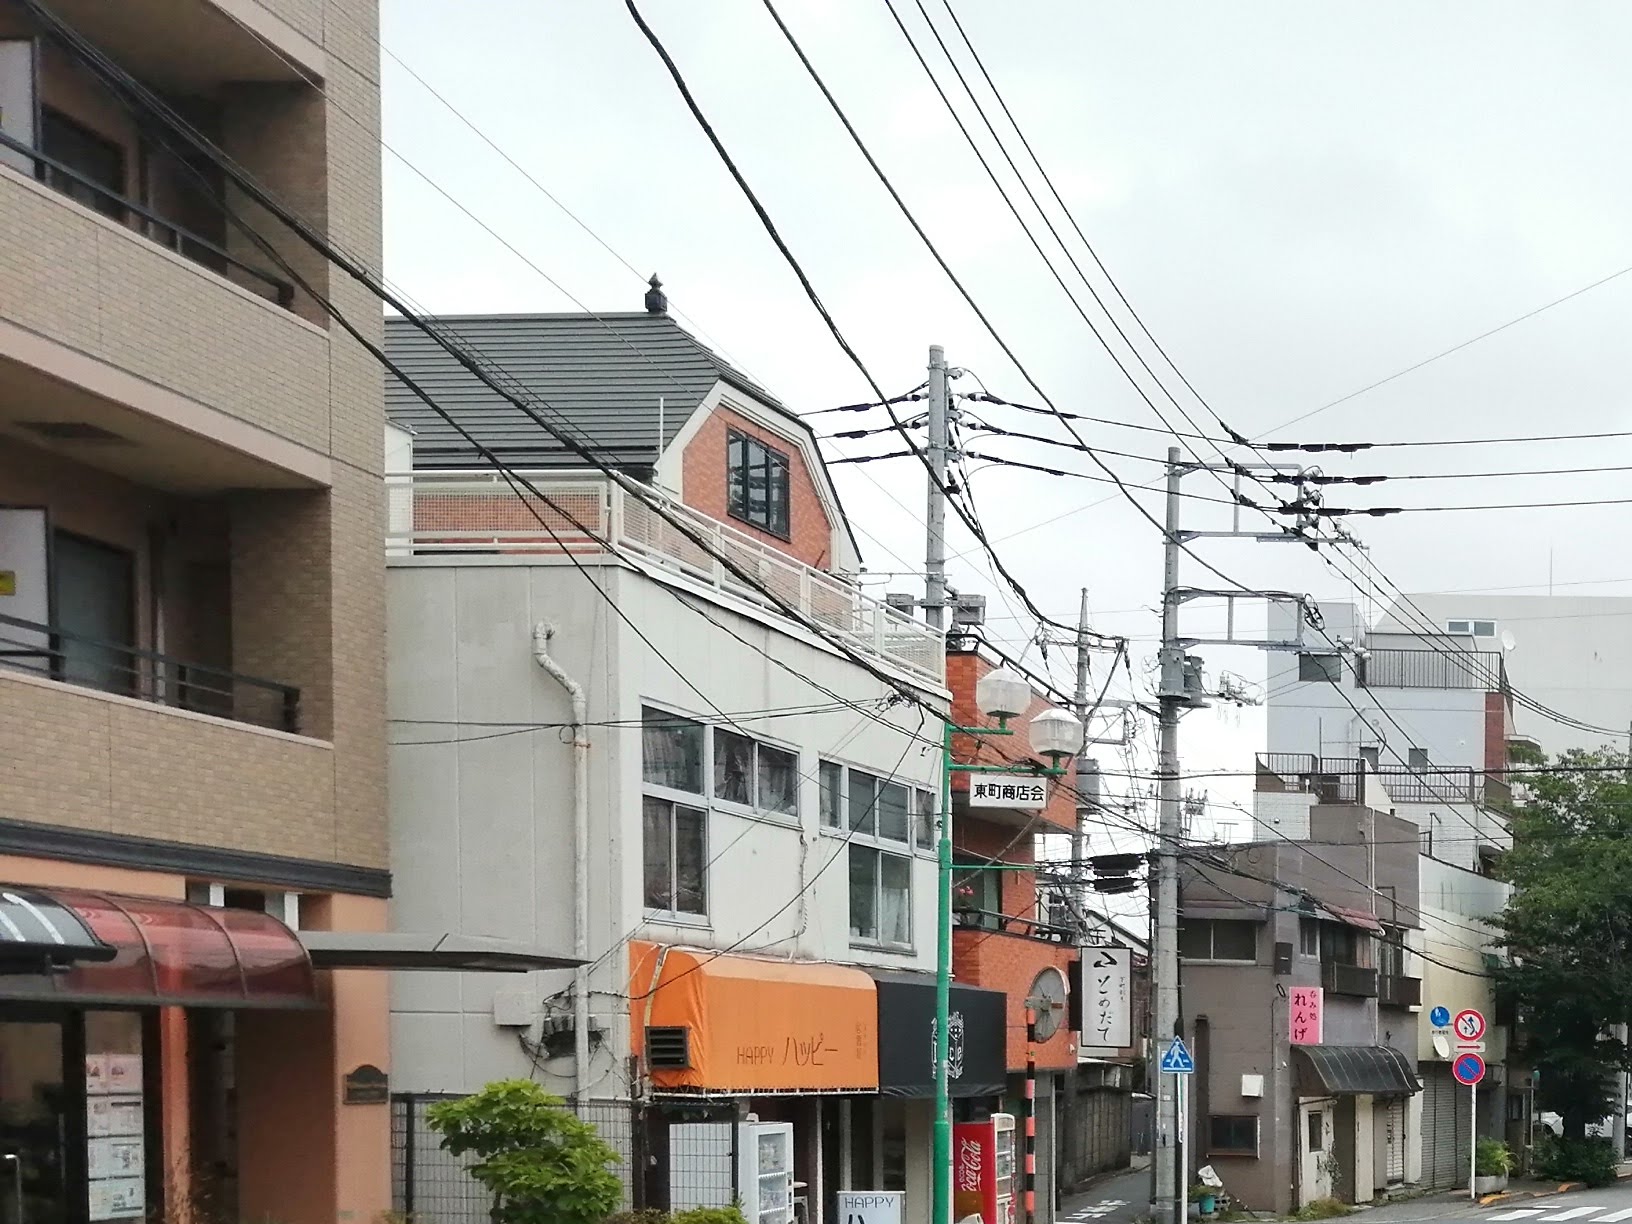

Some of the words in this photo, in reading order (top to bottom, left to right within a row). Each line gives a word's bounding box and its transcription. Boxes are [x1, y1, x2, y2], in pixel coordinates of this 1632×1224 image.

[974, 783, 1045, 802] 東町商店会
[1294, 993, 1308, 1040] れんげ
[737, 1045, 774, 1065] HAPPY
[783, 1032, 838, 1066] ハッピー
[845, 1196, 894, 1209] HAPPY
